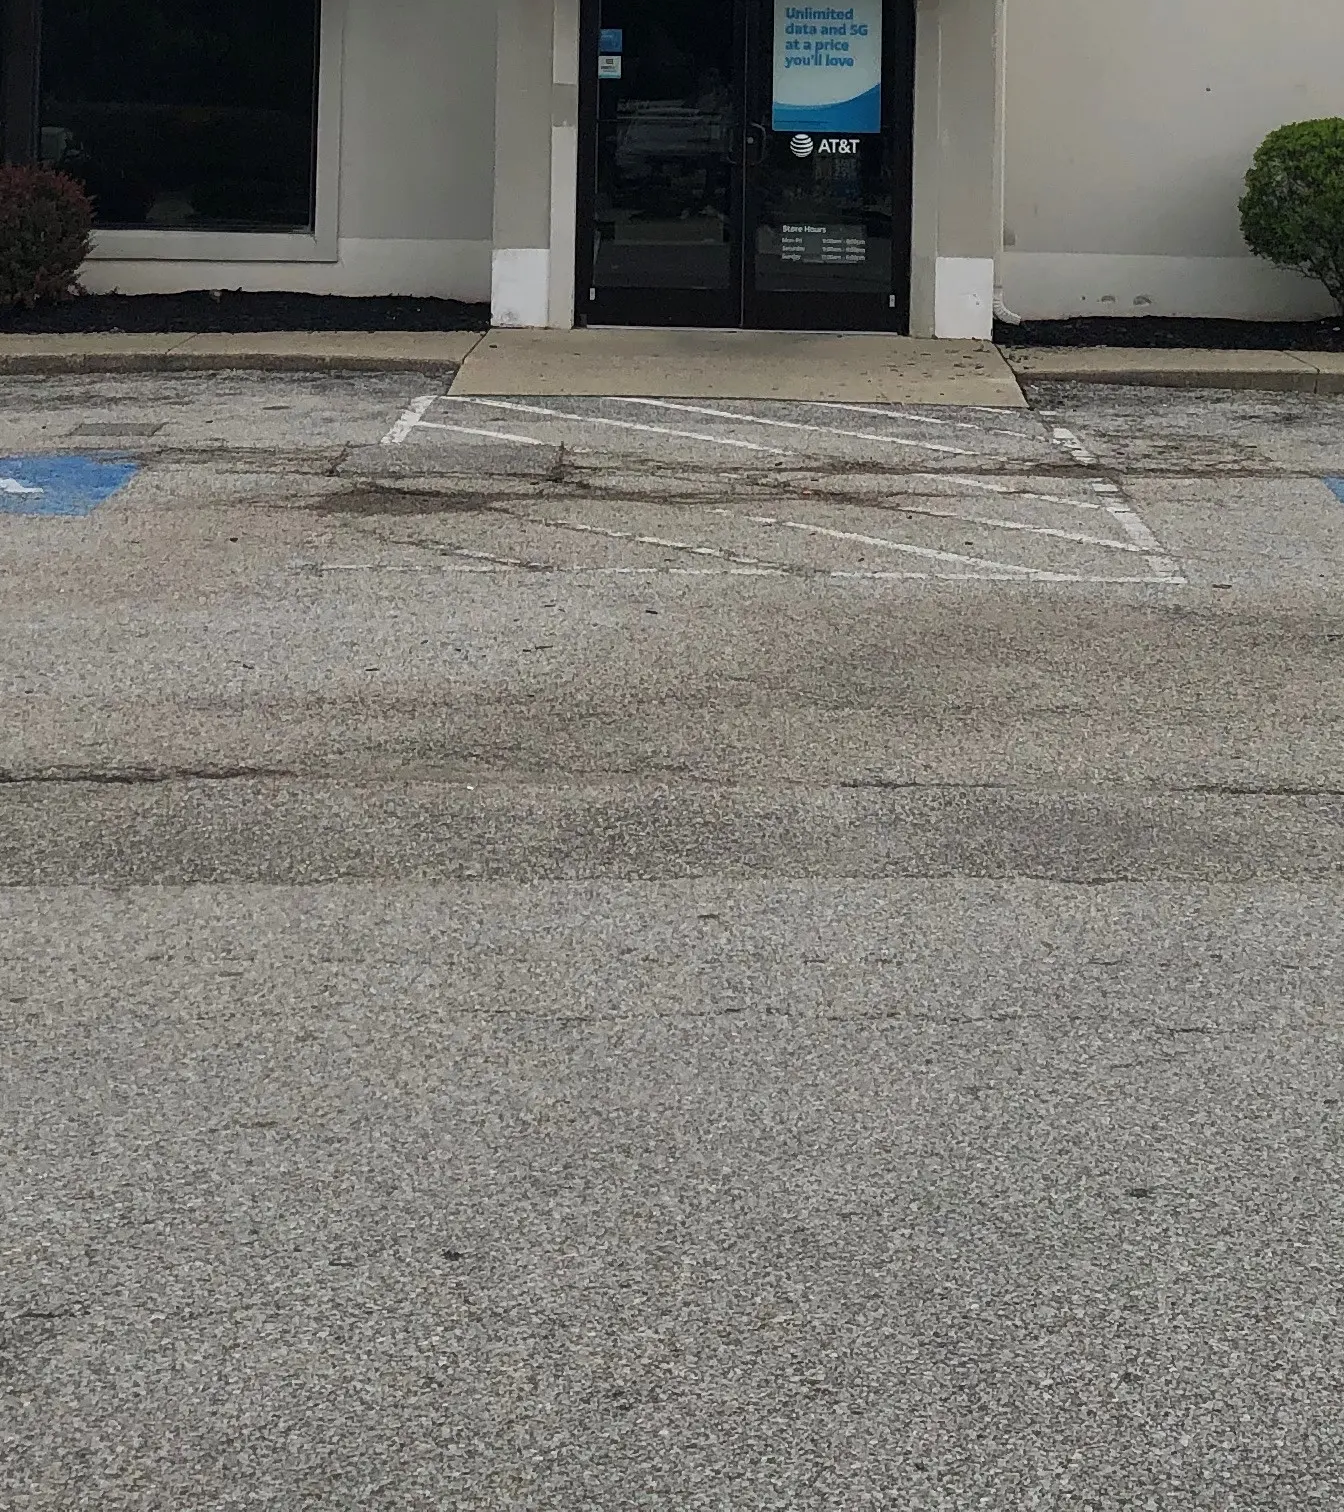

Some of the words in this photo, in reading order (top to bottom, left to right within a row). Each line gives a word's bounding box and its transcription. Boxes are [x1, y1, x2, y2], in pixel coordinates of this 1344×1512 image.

[786, 8, 854, 20] Unlimited
[785, 23, 816, 34] data
[820, 24, 846, 35] and
[850, 25, 868, 36] 5G
[785, 39, 800, 50] at
[803, 41, 811, 50] a
[815, 39, 849, 55] price
[784, 54, 822, 69] you'll
[825, 54, 854, 67] love
[818, 139, 860, 154] AT&T
[782, 225, 803, 233] Store
